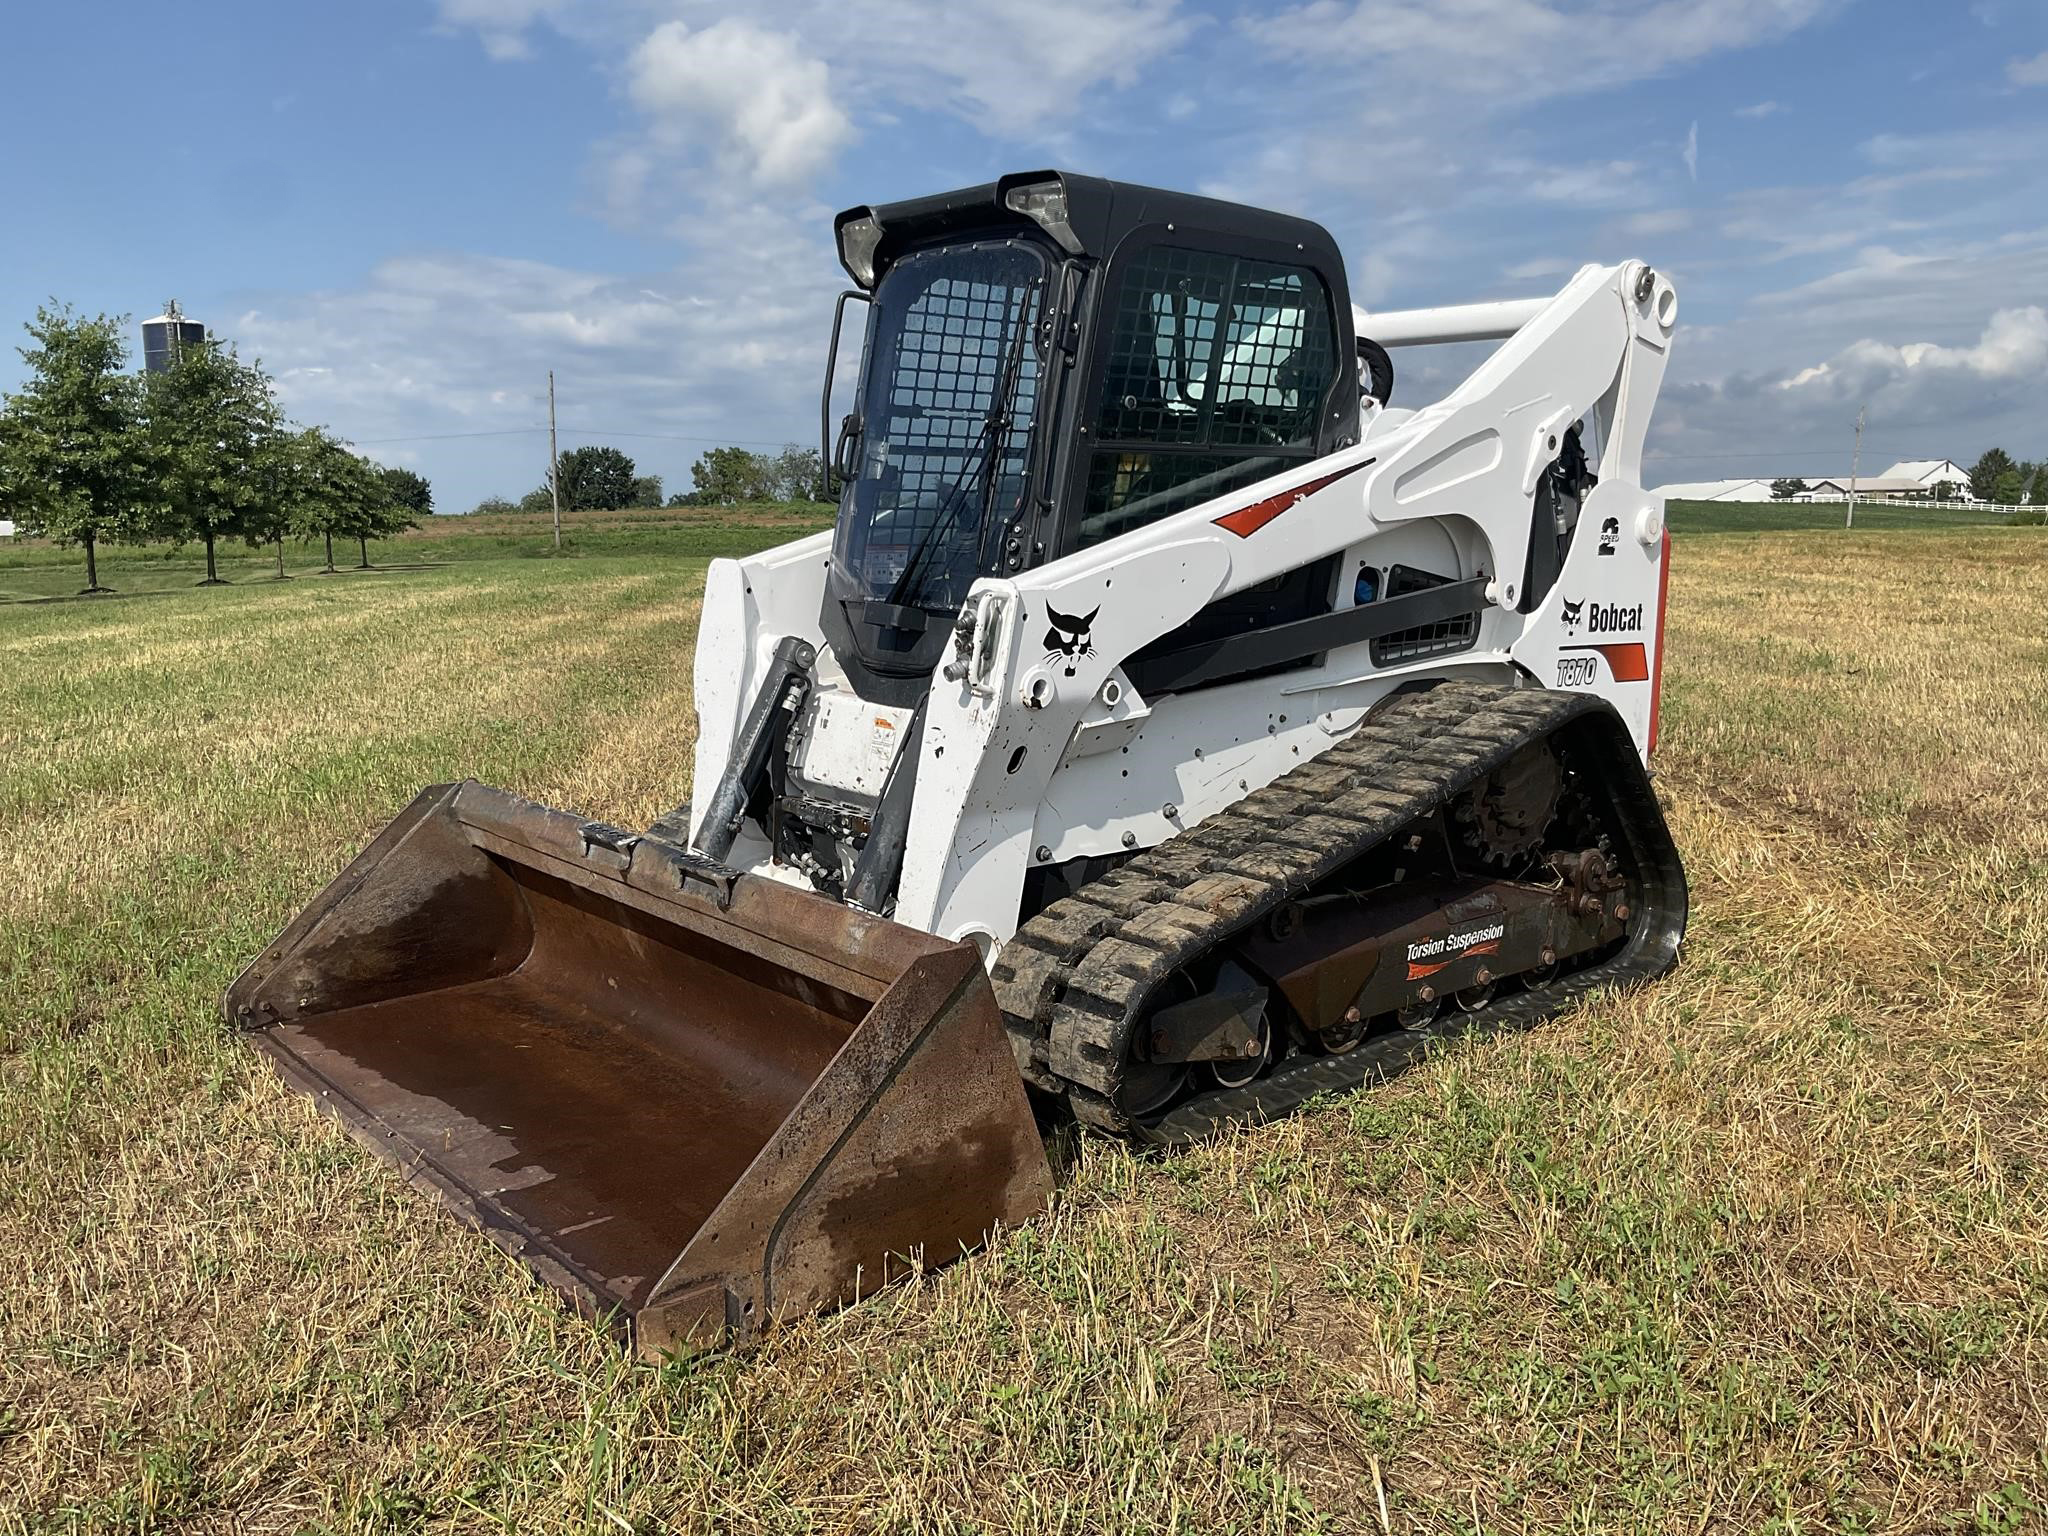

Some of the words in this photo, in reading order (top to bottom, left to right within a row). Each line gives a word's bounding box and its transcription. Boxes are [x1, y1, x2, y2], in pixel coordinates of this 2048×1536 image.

[1598, 517, 1619, 555] 2
[1599, 534, 1620, 543] SPEED
[1588, 603, 1643, 632] Bobcat
[1557, 657, 1597, 687] T870
[1407, 939, 1445, 961] Torsion
[1446, 924, 1504, 951] Suspension
